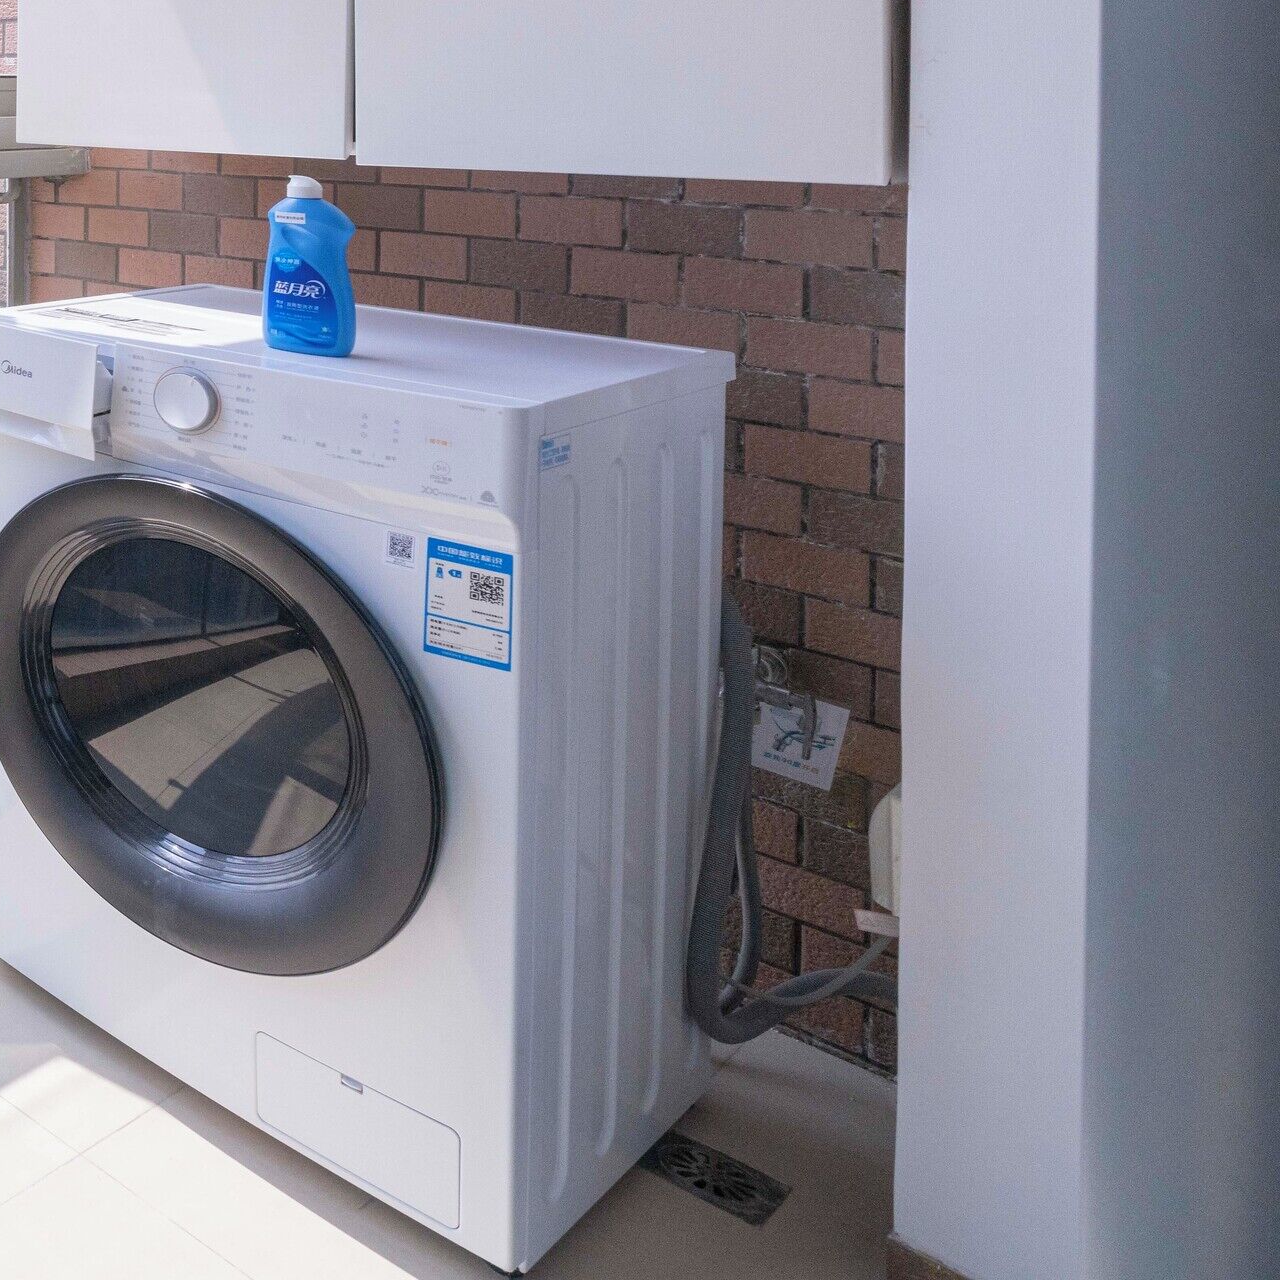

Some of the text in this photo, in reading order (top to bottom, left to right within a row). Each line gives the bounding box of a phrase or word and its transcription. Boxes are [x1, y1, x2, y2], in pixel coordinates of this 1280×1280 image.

[273, 280, 326, 299] 蓝月亮
[1, 360, 33, 378] Midea
